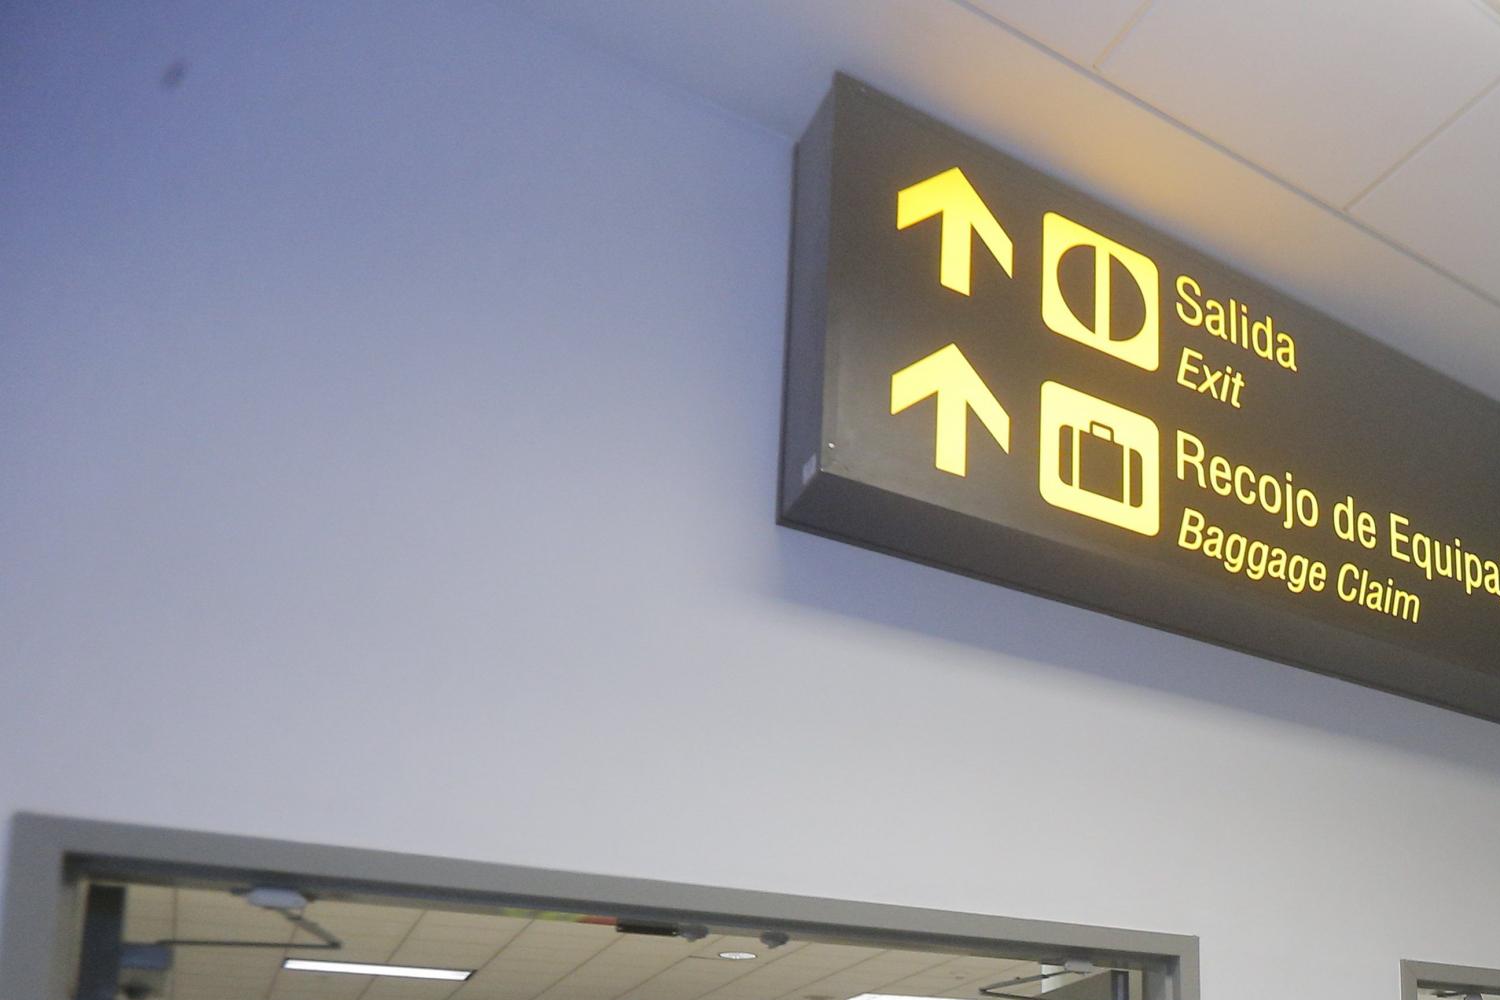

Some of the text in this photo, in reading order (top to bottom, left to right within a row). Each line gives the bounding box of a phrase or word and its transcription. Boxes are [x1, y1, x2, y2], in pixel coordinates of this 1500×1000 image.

[1176, 276, 1298, 372] Salida
[1177, 348, 1245, 409] Exit
[1176, 429, 1319, 528] Recojo
[1333, 496, 1377, 549] de
[1178, 507, 1420, 623] Baggage Claim
